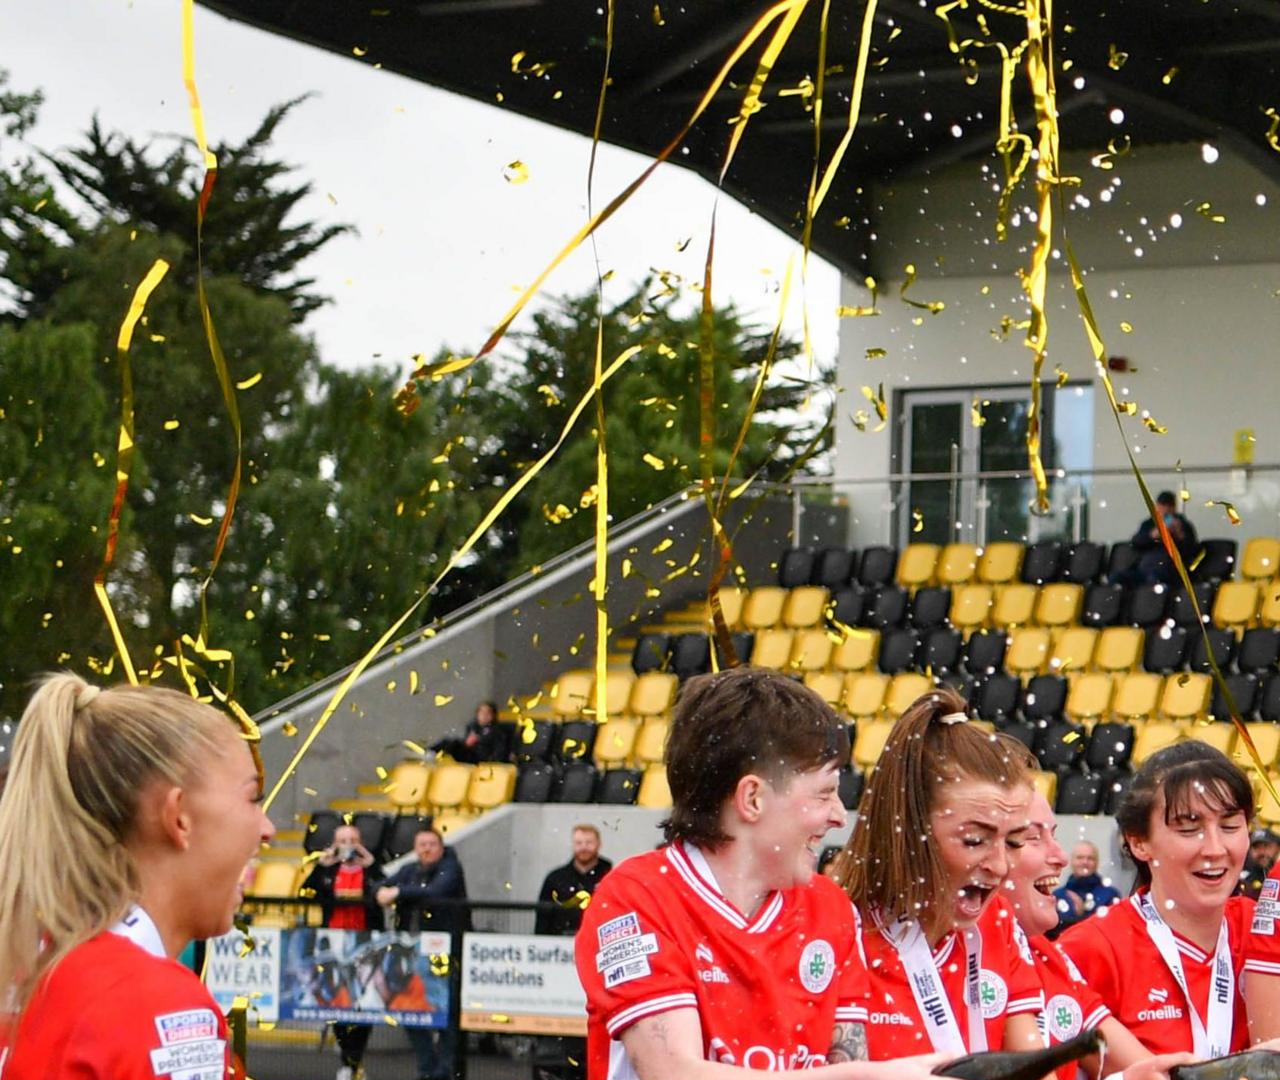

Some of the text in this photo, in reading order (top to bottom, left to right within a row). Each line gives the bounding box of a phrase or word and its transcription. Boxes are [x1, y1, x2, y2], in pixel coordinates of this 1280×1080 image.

[470, 942, 522, 963] Sports
[212, 963, 273, 985] WEAR
[470, 967, 544, 987] Solutions
[1216, 977, 1230, 1004] nifl
